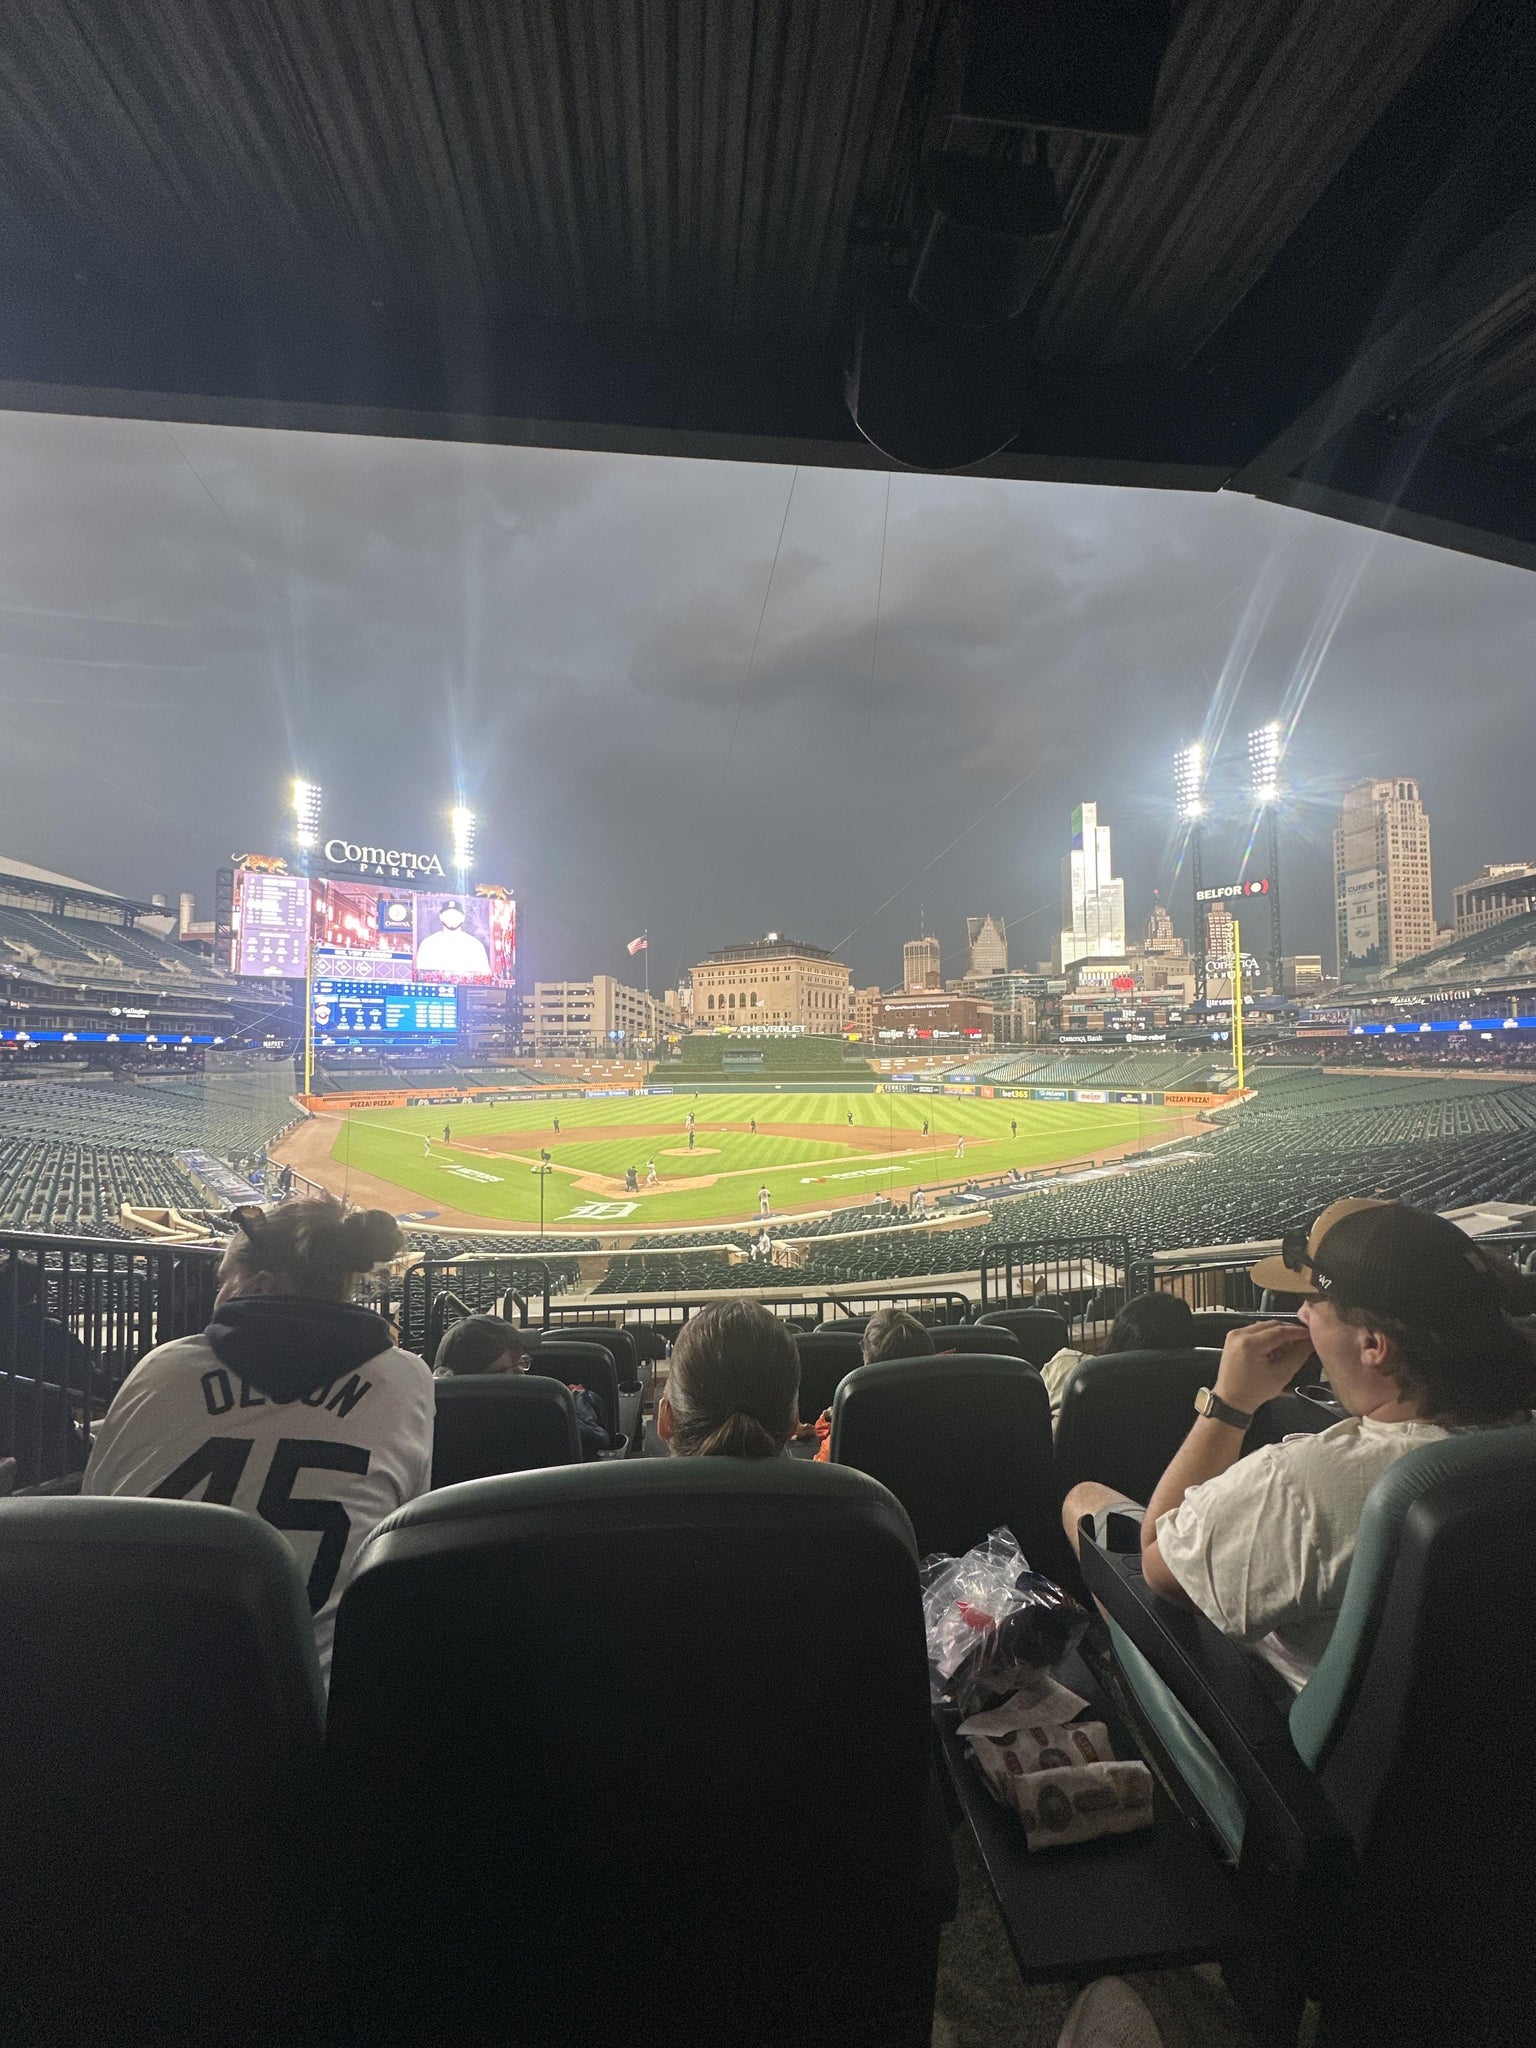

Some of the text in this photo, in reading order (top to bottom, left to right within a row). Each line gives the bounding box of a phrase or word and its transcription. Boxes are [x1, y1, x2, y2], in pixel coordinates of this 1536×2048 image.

[360, 863, 415, 879] PARK
[1197, 886, 1242, 900] BELFOR
[740, 1025, 806, 1034] CHEVROLET
[879, 1030, 904, 1039] meijer
[1002, 1089, 1029, 1098] bet365
[1081, 1093, 1102, 1101] meijer
[350, 1099, 395, 1108] PIZZA! PIZZA!
[1165, 1095, 1210, 1104] PIZZA! PIZZA!
